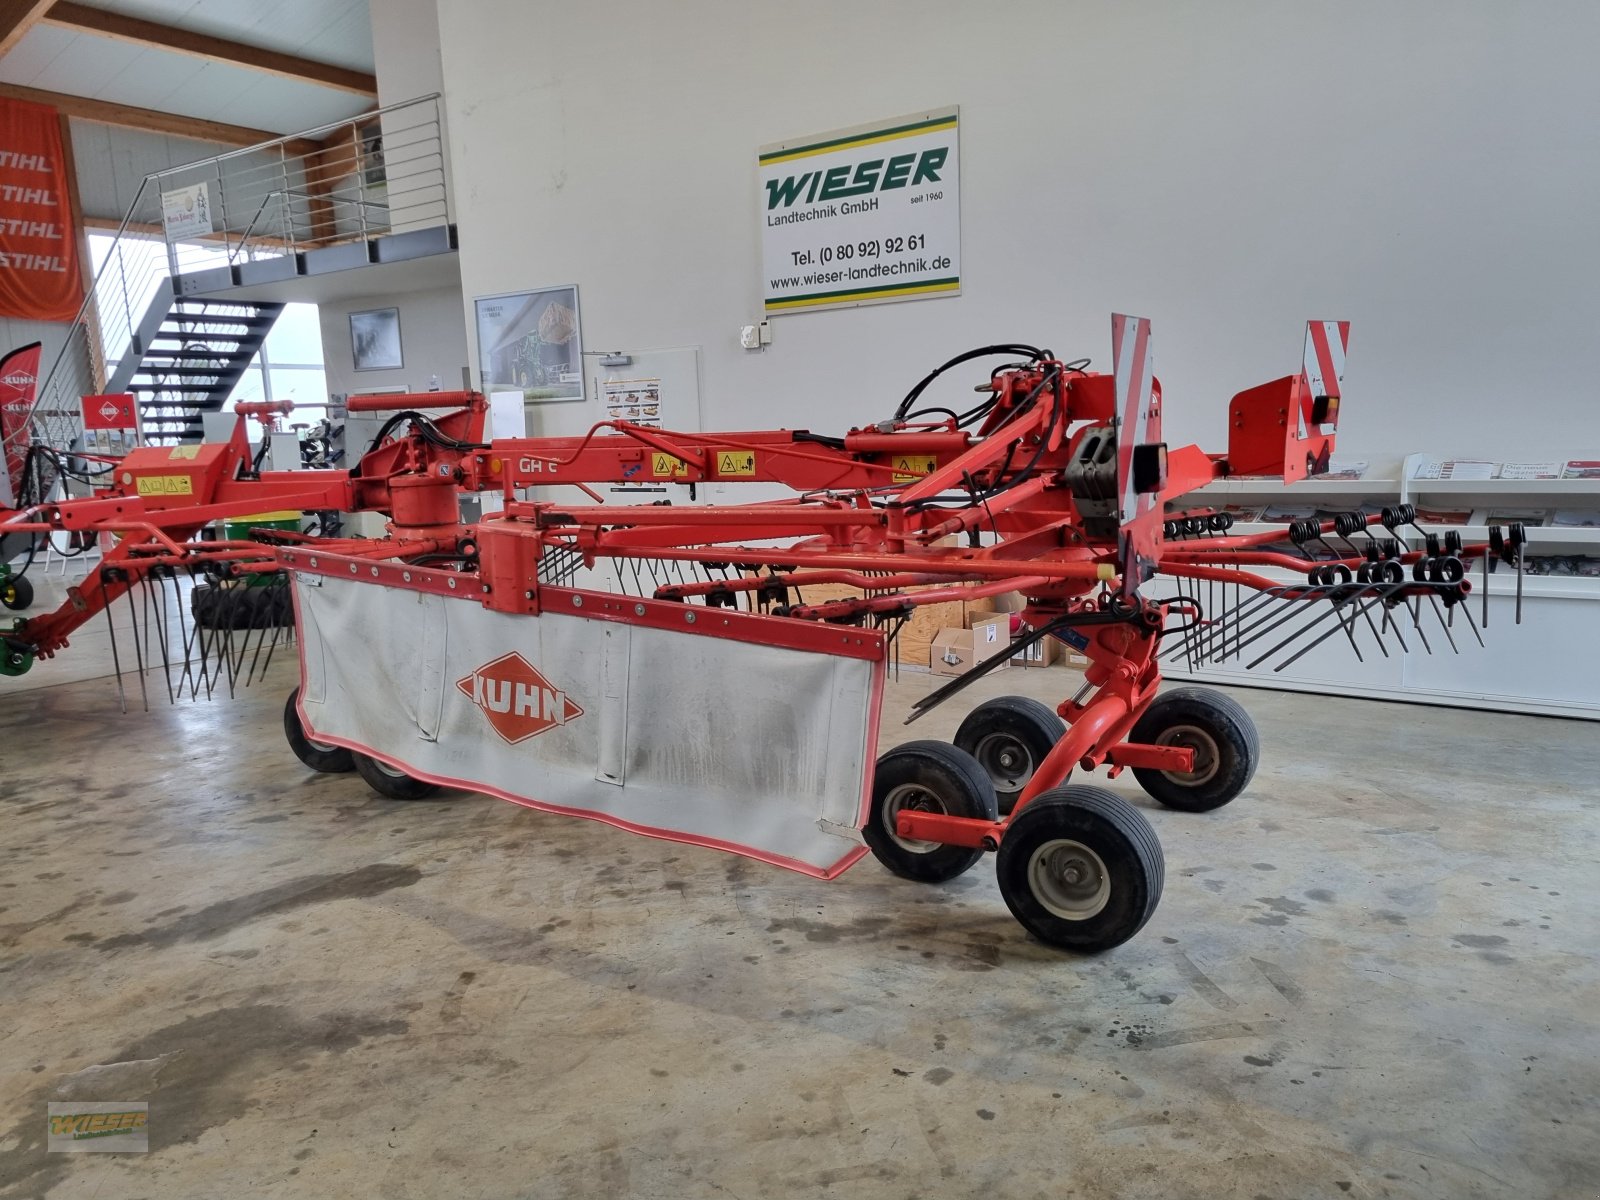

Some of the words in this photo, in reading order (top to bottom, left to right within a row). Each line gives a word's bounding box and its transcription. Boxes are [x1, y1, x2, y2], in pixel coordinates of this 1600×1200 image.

[0, 150, 52, 173] TIHL
[766, 147, 949, 210] WIESER
[0, 184, 57, 206] TIHL
[910, 194, 923, 204] seit
[925, 191, 943, 203] 1960
[768, 205, 838, 227] Landtechnik
[840, 198, 879, 216] GmbH
[0, 251, 66, 272] STIHL
[792, 250, 815, 266] Tel.
[819, 247, 832, 265] (0
[836, 245, 854, 260] 80
[858, 241, 880, 259] 92)
[885, 237, 903, 253] 92
[908, 234, 925, 250] 61
[771, 256, 951, 289] www.wieser-landtechnik.de
[5, 376, 34, 384] KUHN
[472, 671, 565, 726] KUHN
